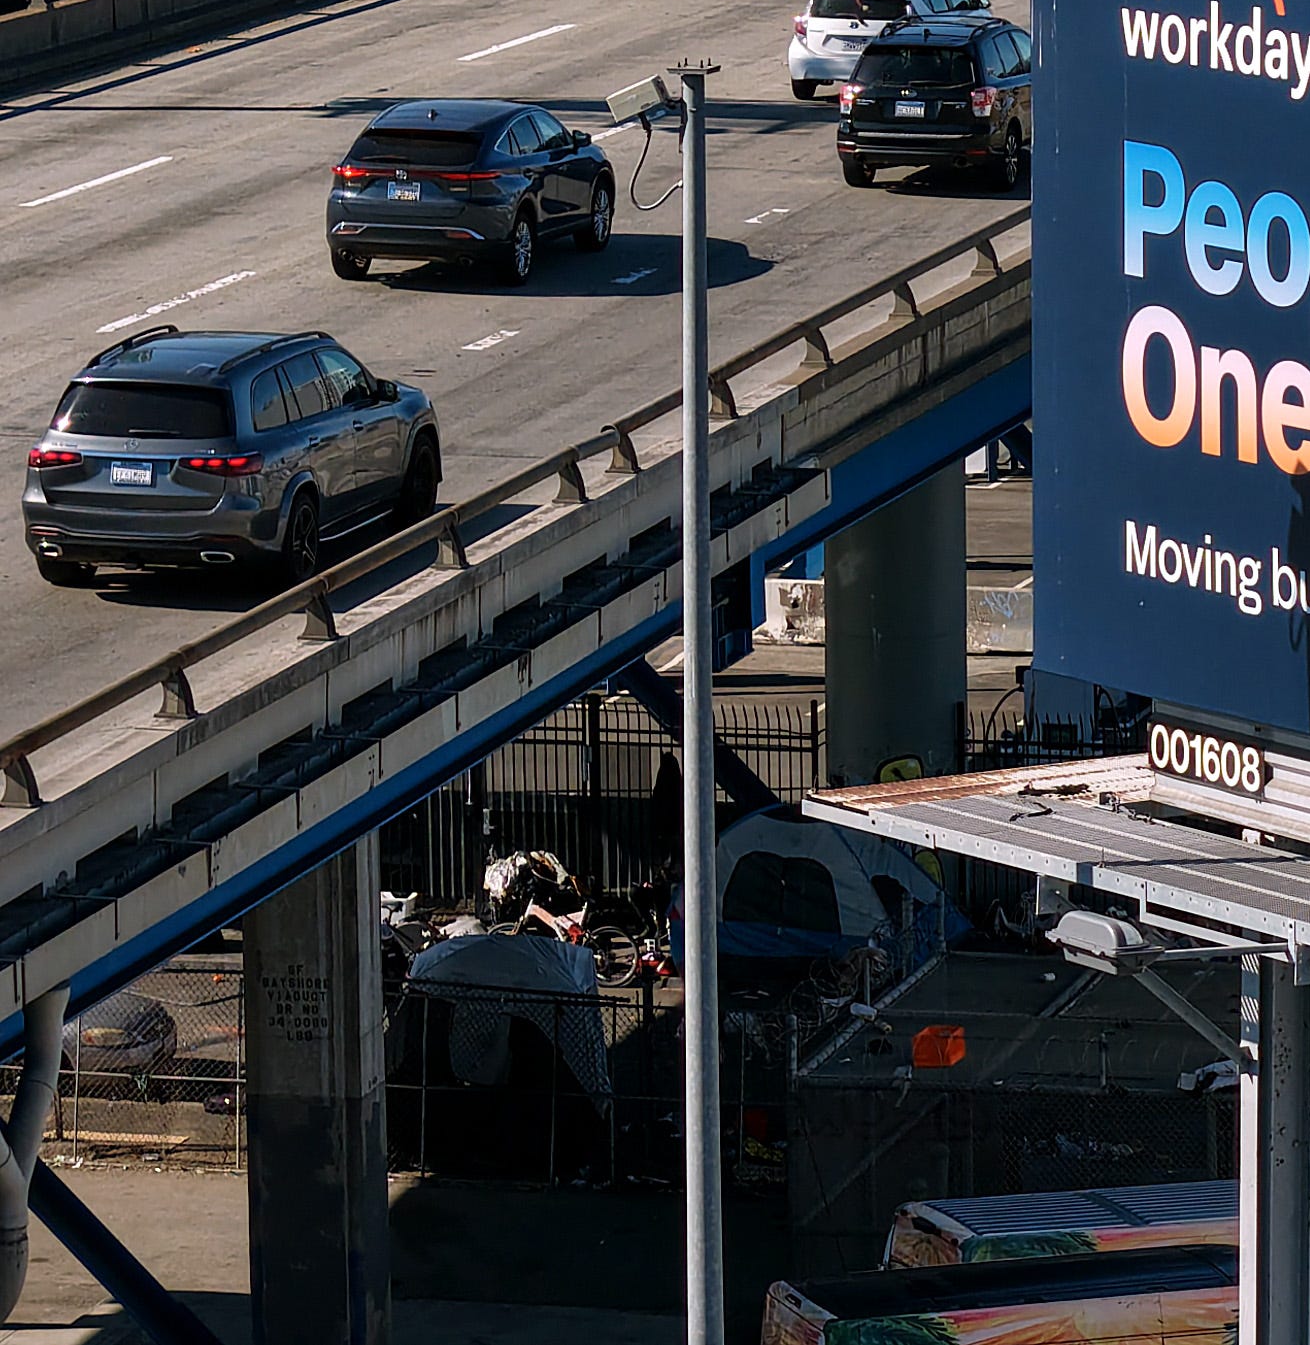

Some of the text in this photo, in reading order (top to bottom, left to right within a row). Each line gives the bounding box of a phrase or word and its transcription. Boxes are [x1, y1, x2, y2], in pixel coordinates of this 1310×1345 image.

[1124, 520, 1262, 616] Moving
[1149, 723, 1262, 795] 001608
[267, 991, 327, 1003] VIADUCT
